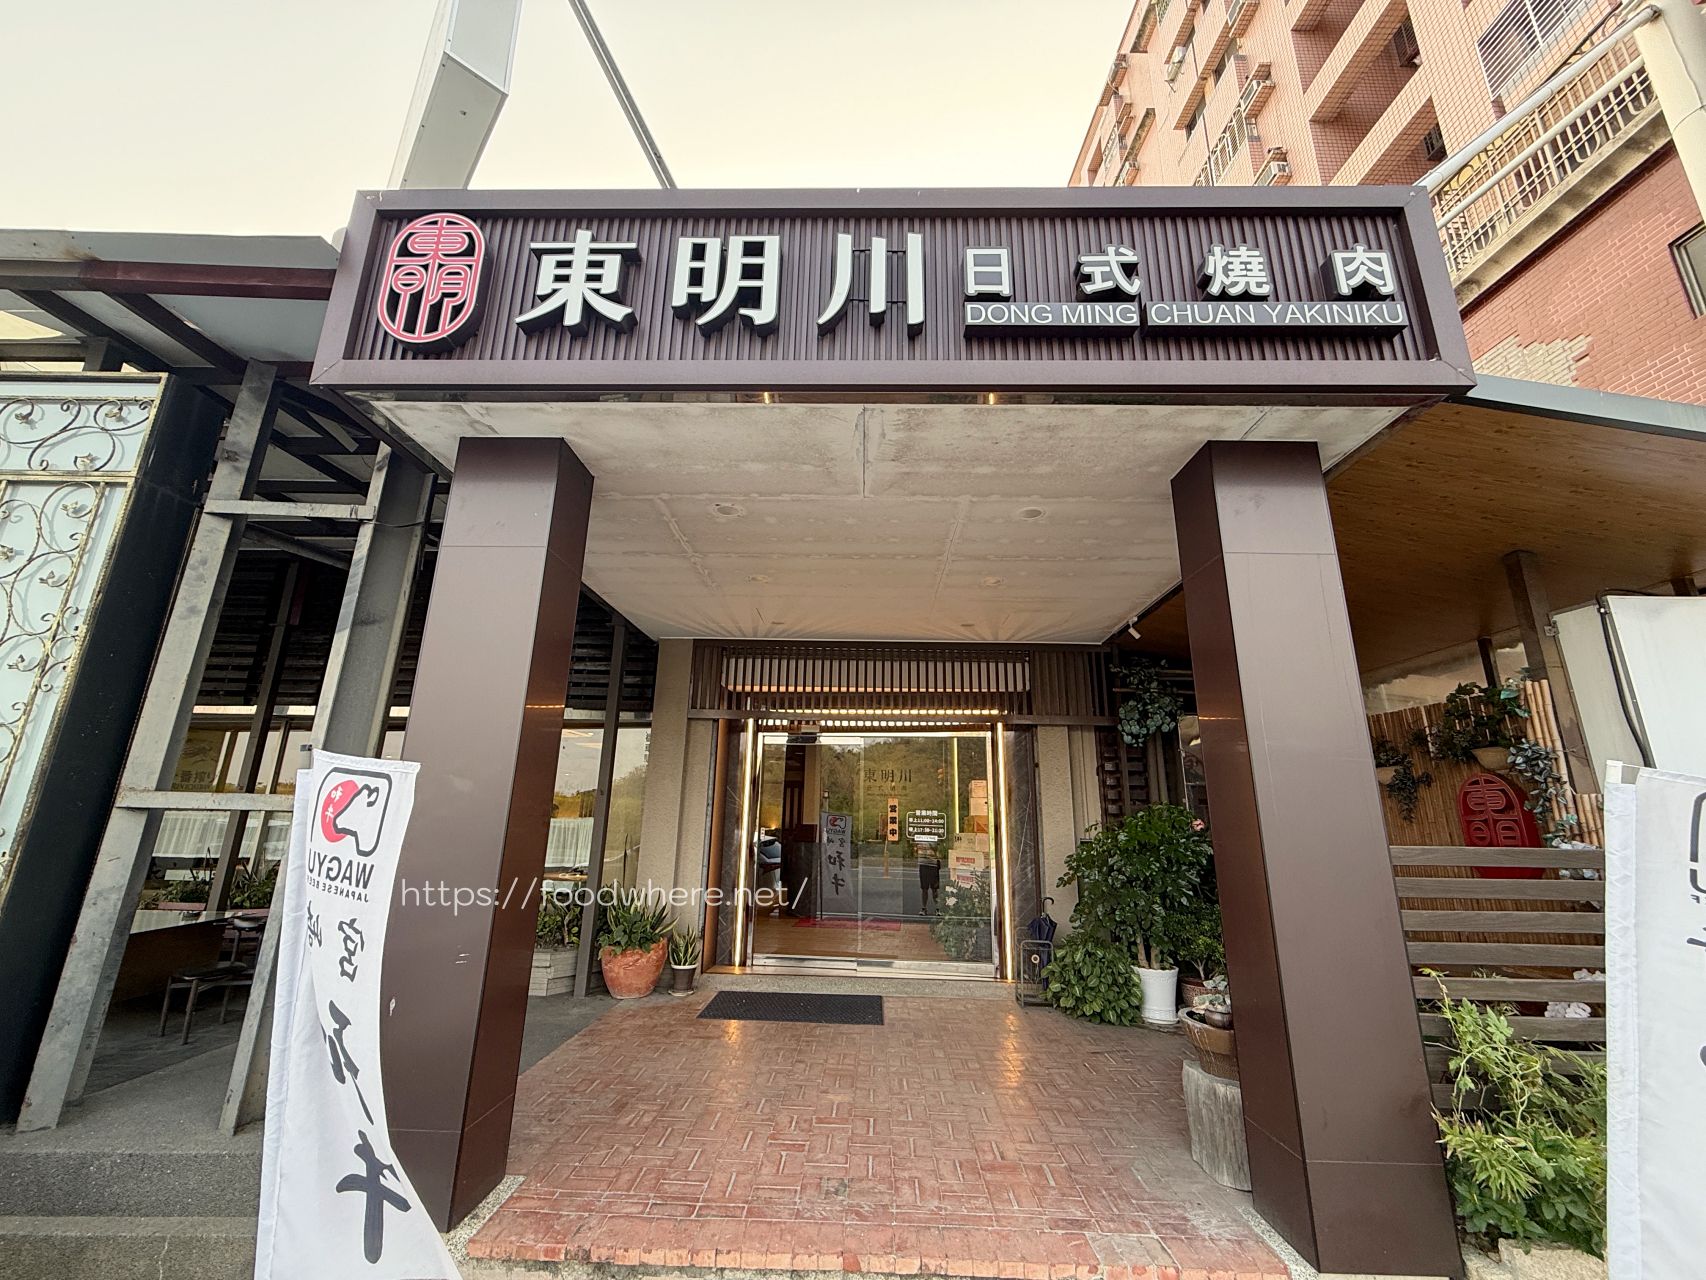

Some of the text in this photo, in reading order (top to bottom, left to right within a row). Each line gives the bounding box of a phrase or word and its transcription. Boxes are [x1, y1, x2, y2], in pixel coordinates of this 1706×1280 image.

[515, 228, 926, 328] 東明川
[964, 245, 1397, 298] 日式燒肉
[966, 303, 1405, 325] DONG MING CHUAN YAKINIKU
[864, 768, 912, 783] 東明川
